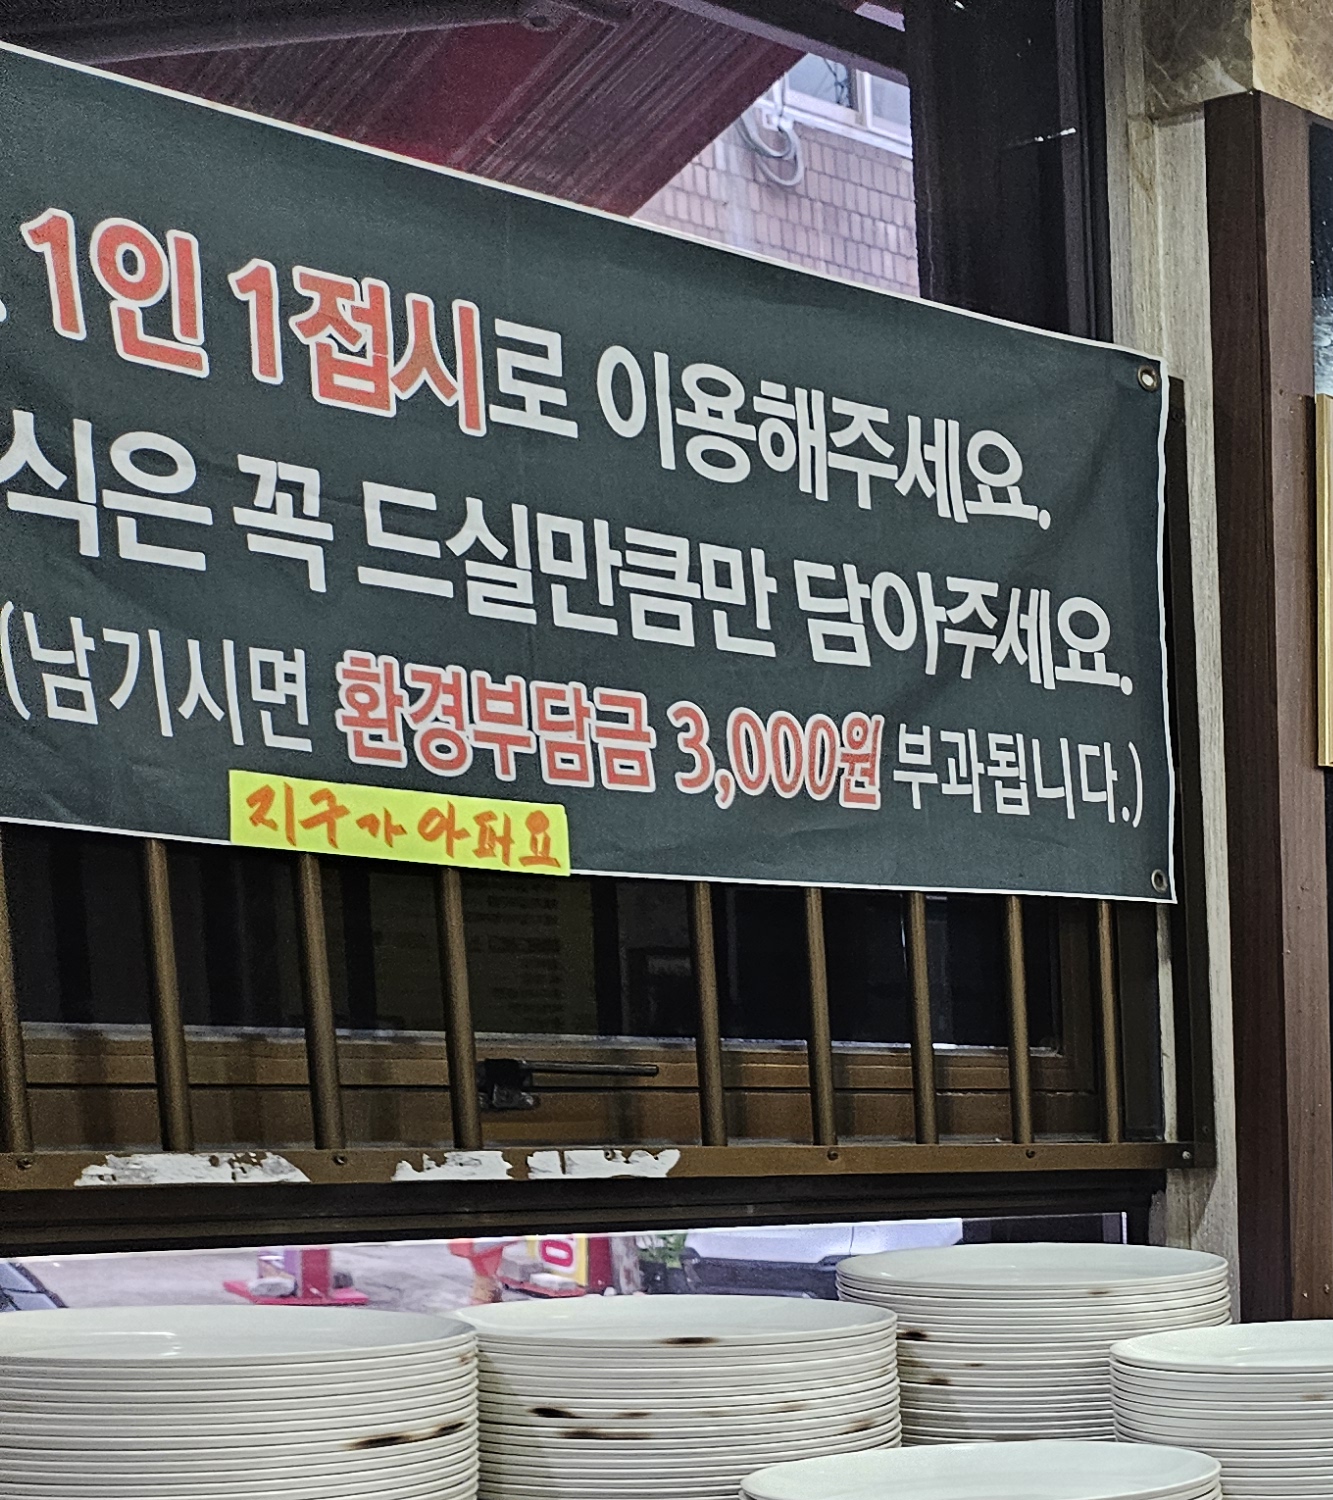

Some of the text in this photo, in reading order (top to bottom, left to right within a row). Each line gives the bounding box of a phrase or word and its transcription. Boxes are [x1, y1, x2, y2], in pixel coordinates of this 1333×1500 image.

[20, 207, 1051, 530] 1인 1접시로 이용해주세요.
[233, 453, 334, 593] 꼭
[357, 481, 778, 657] 드실만큼만
[794, 559, 1133, 695] 담아주세요.
[0, 601, 1144, 828] (남기시면 환경부담금 3,000원 부과됩니다.)
